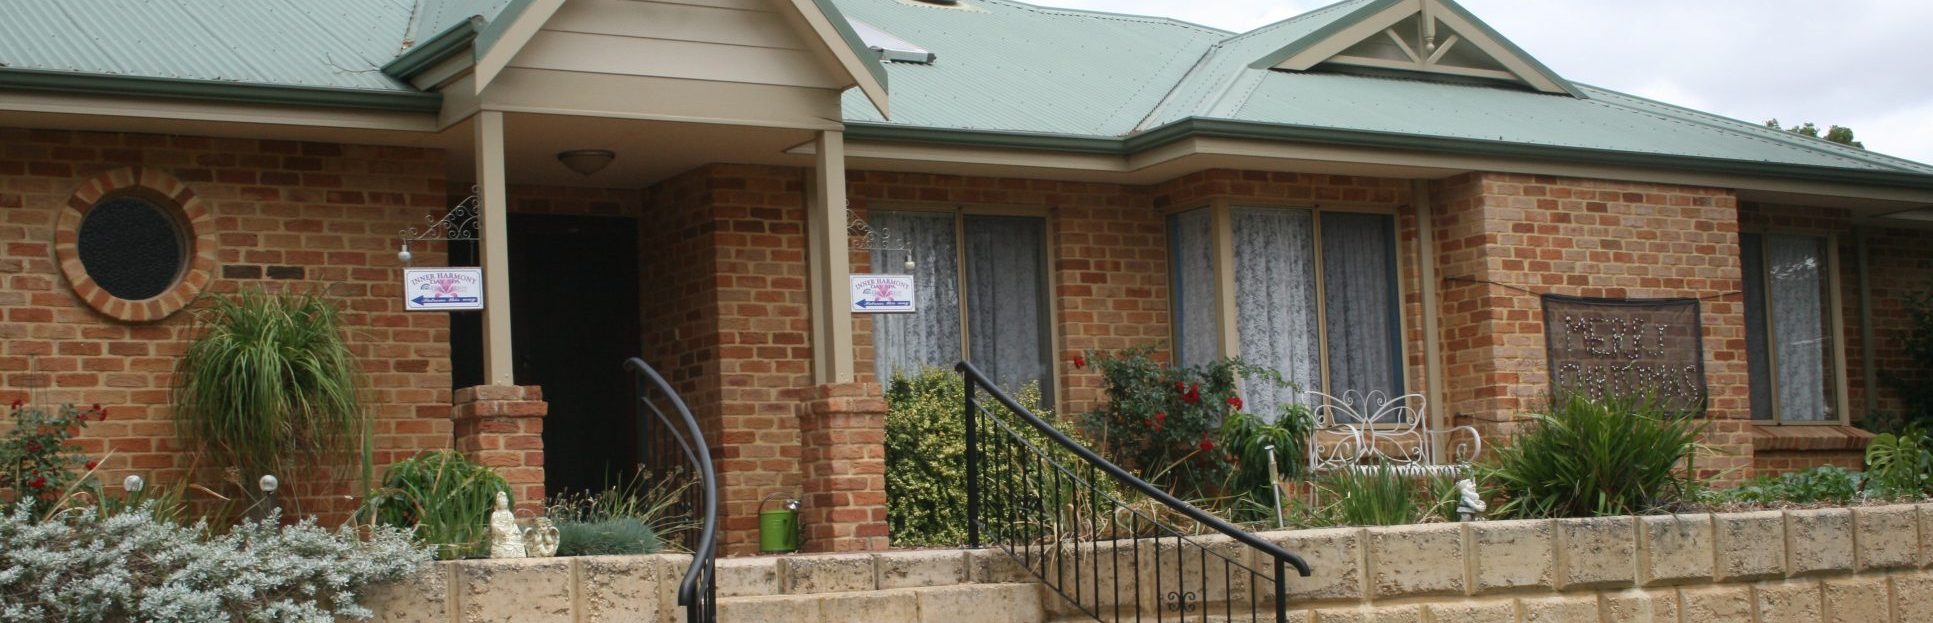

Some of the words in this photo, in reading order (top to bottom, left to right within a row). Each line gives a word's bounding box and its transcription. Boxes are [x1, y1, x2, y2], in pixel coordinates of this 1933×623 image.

[411, 273, 435, 286] INNER
[437, 272, 477, 285] HARMONY
[855, 279, 875, 290] INNER
[876, 278, 910, 290] HARMONY
